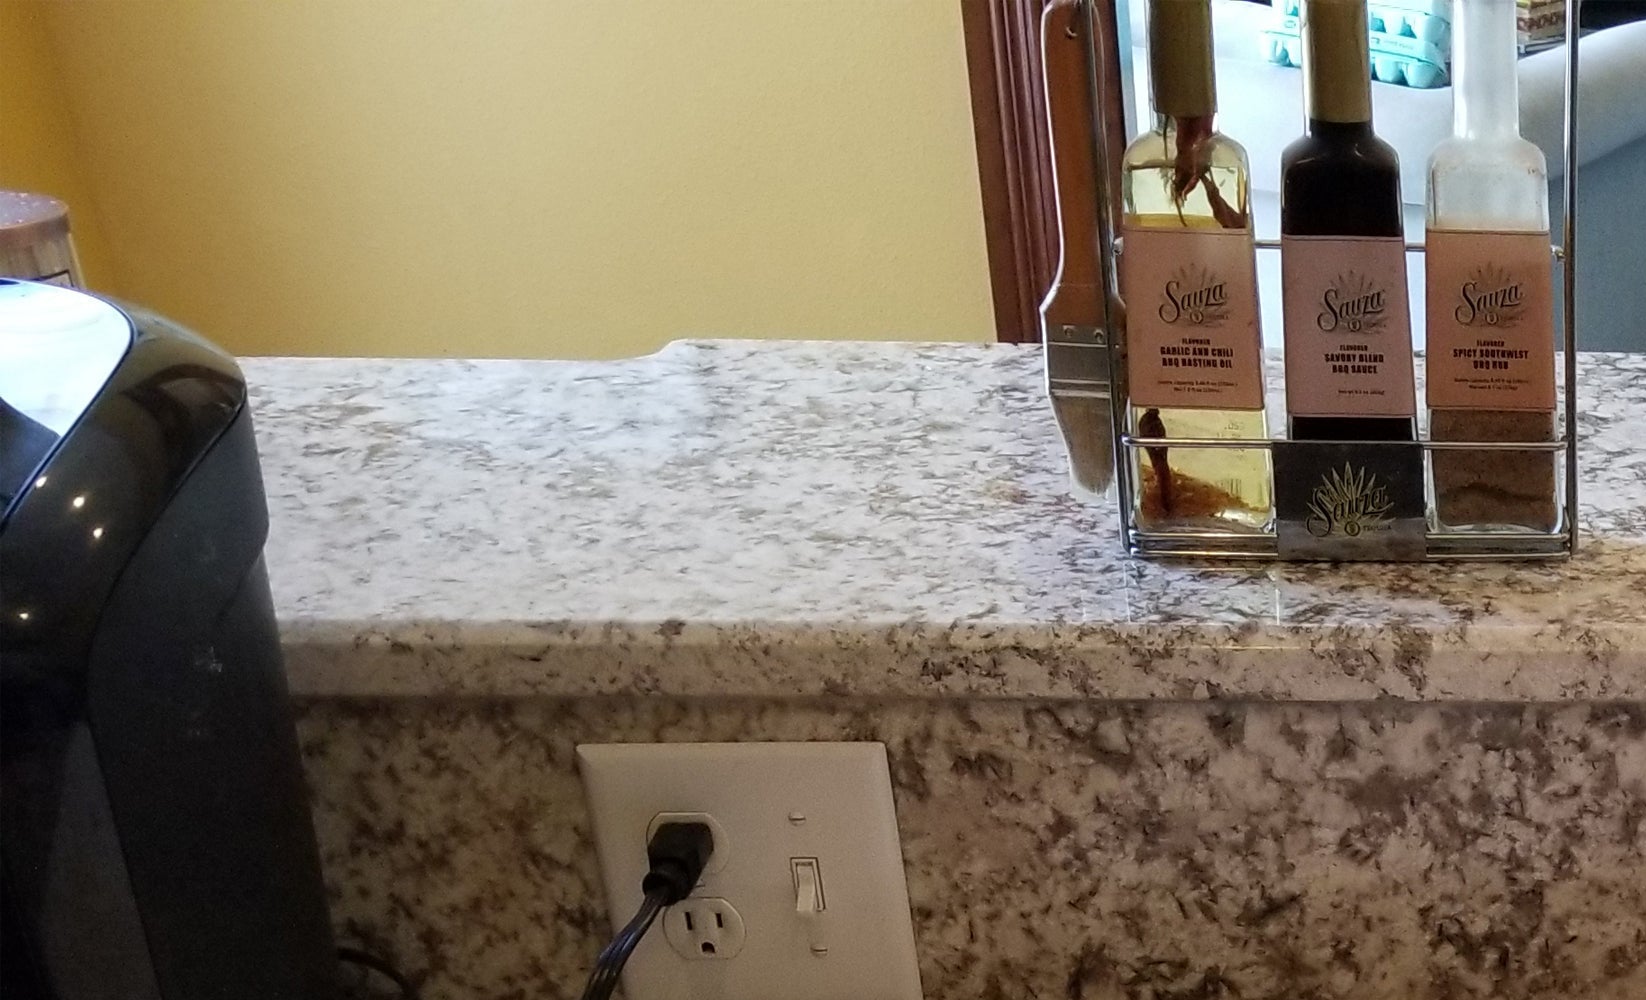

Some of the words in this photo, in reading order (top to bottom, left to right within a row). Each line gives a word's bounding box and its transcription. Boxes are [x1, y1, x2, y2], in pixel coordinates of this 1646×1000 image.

[1159, 281, 1228, 324] Sauza
[1455, 282, 1523, 326] Sauza
[1317, 288, 1386, 332] Sauza
[1160, 347, 1190, 356] GARLIC
[1192, 348, 1209, 357] AND
[1211, 348, 1234, 358] CHILI
[1325, 353, 1356, 363] SAVORY
[1359, 354, 1384, 363] BLEND
[1453, 348, 1477, 358] SPICY
[1479, 349, 1528, 359] SOUTHWEST
[1162, 358, 1179, 368] BBQ
[1181, 358, 1217, 368] BASTING
[1220, 359, 1233, 369] OIL
[1332, 365, 1349, 374] BBQ
[1351, 365, 1377, 374] SAUCE
[1306, 486, 1394, 538] Sauza
